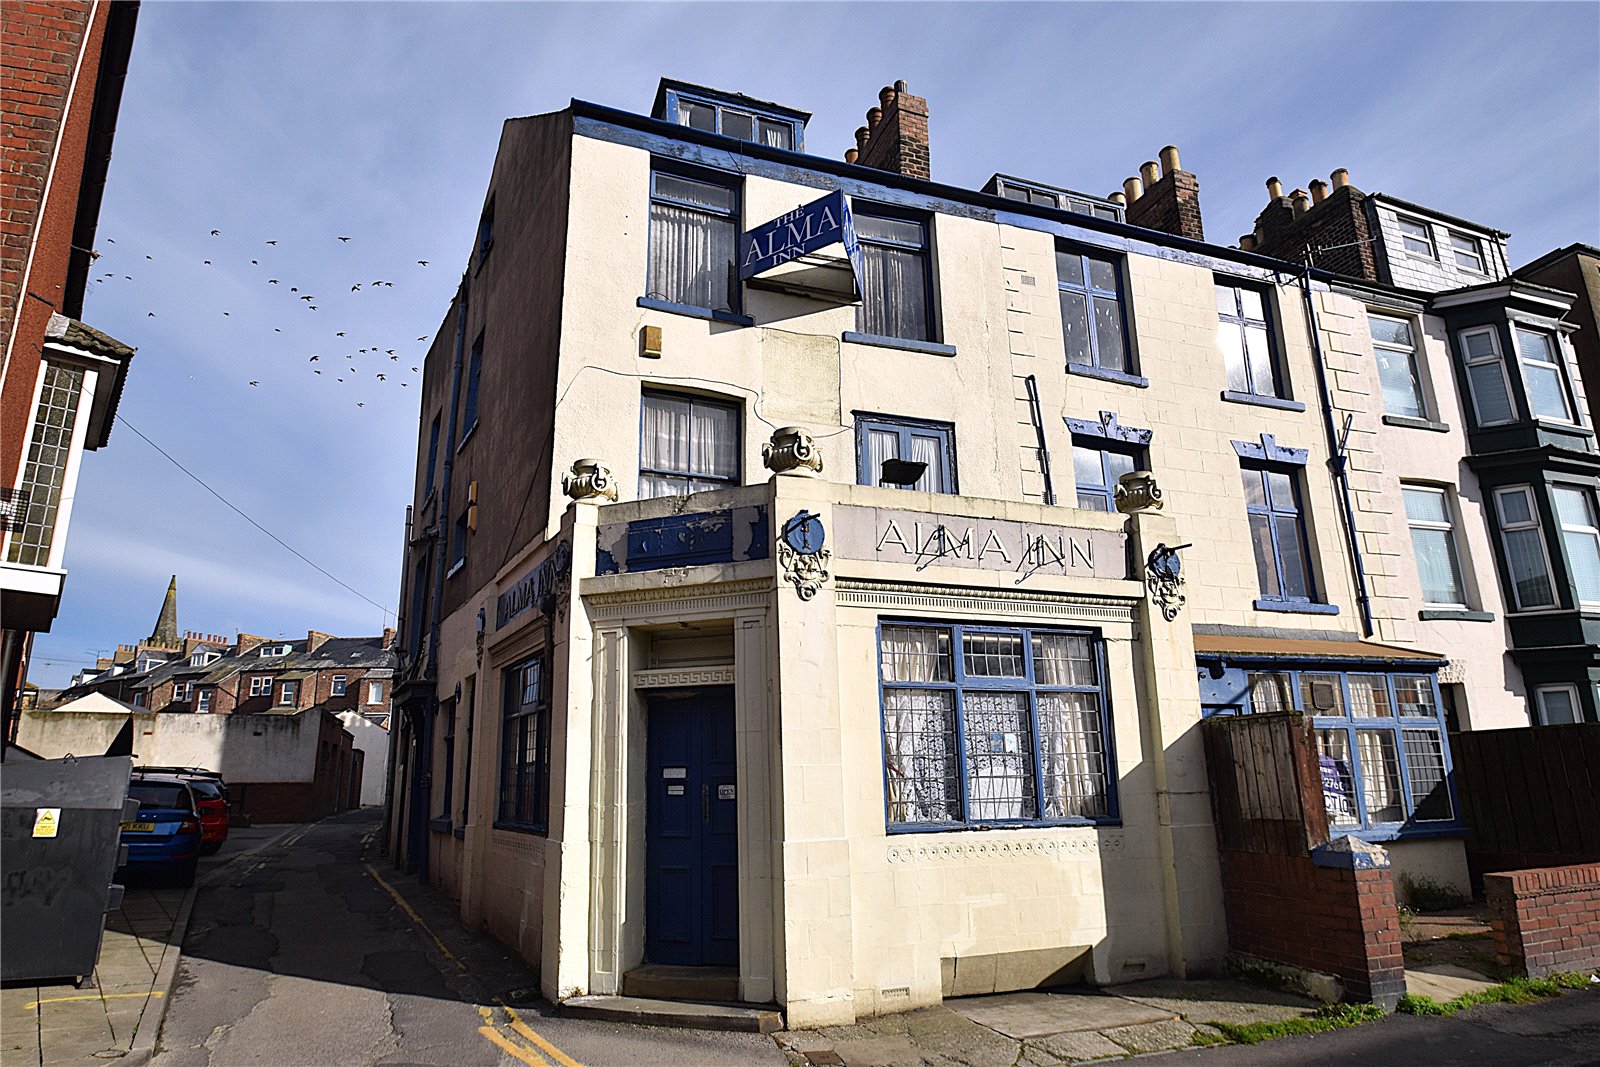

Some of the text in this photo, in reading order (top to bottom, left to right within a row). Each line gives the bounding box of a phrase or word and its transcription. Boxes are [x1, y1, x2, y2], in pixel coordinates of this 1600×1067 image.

[742, 206, 840, 268] ALMA
[773, 207, 805, 228] THE
[773, 243, 805, 266] INN
[876, 519, 1094, 569] ALMA INN
[504, 577, 534, 622] ALMA
